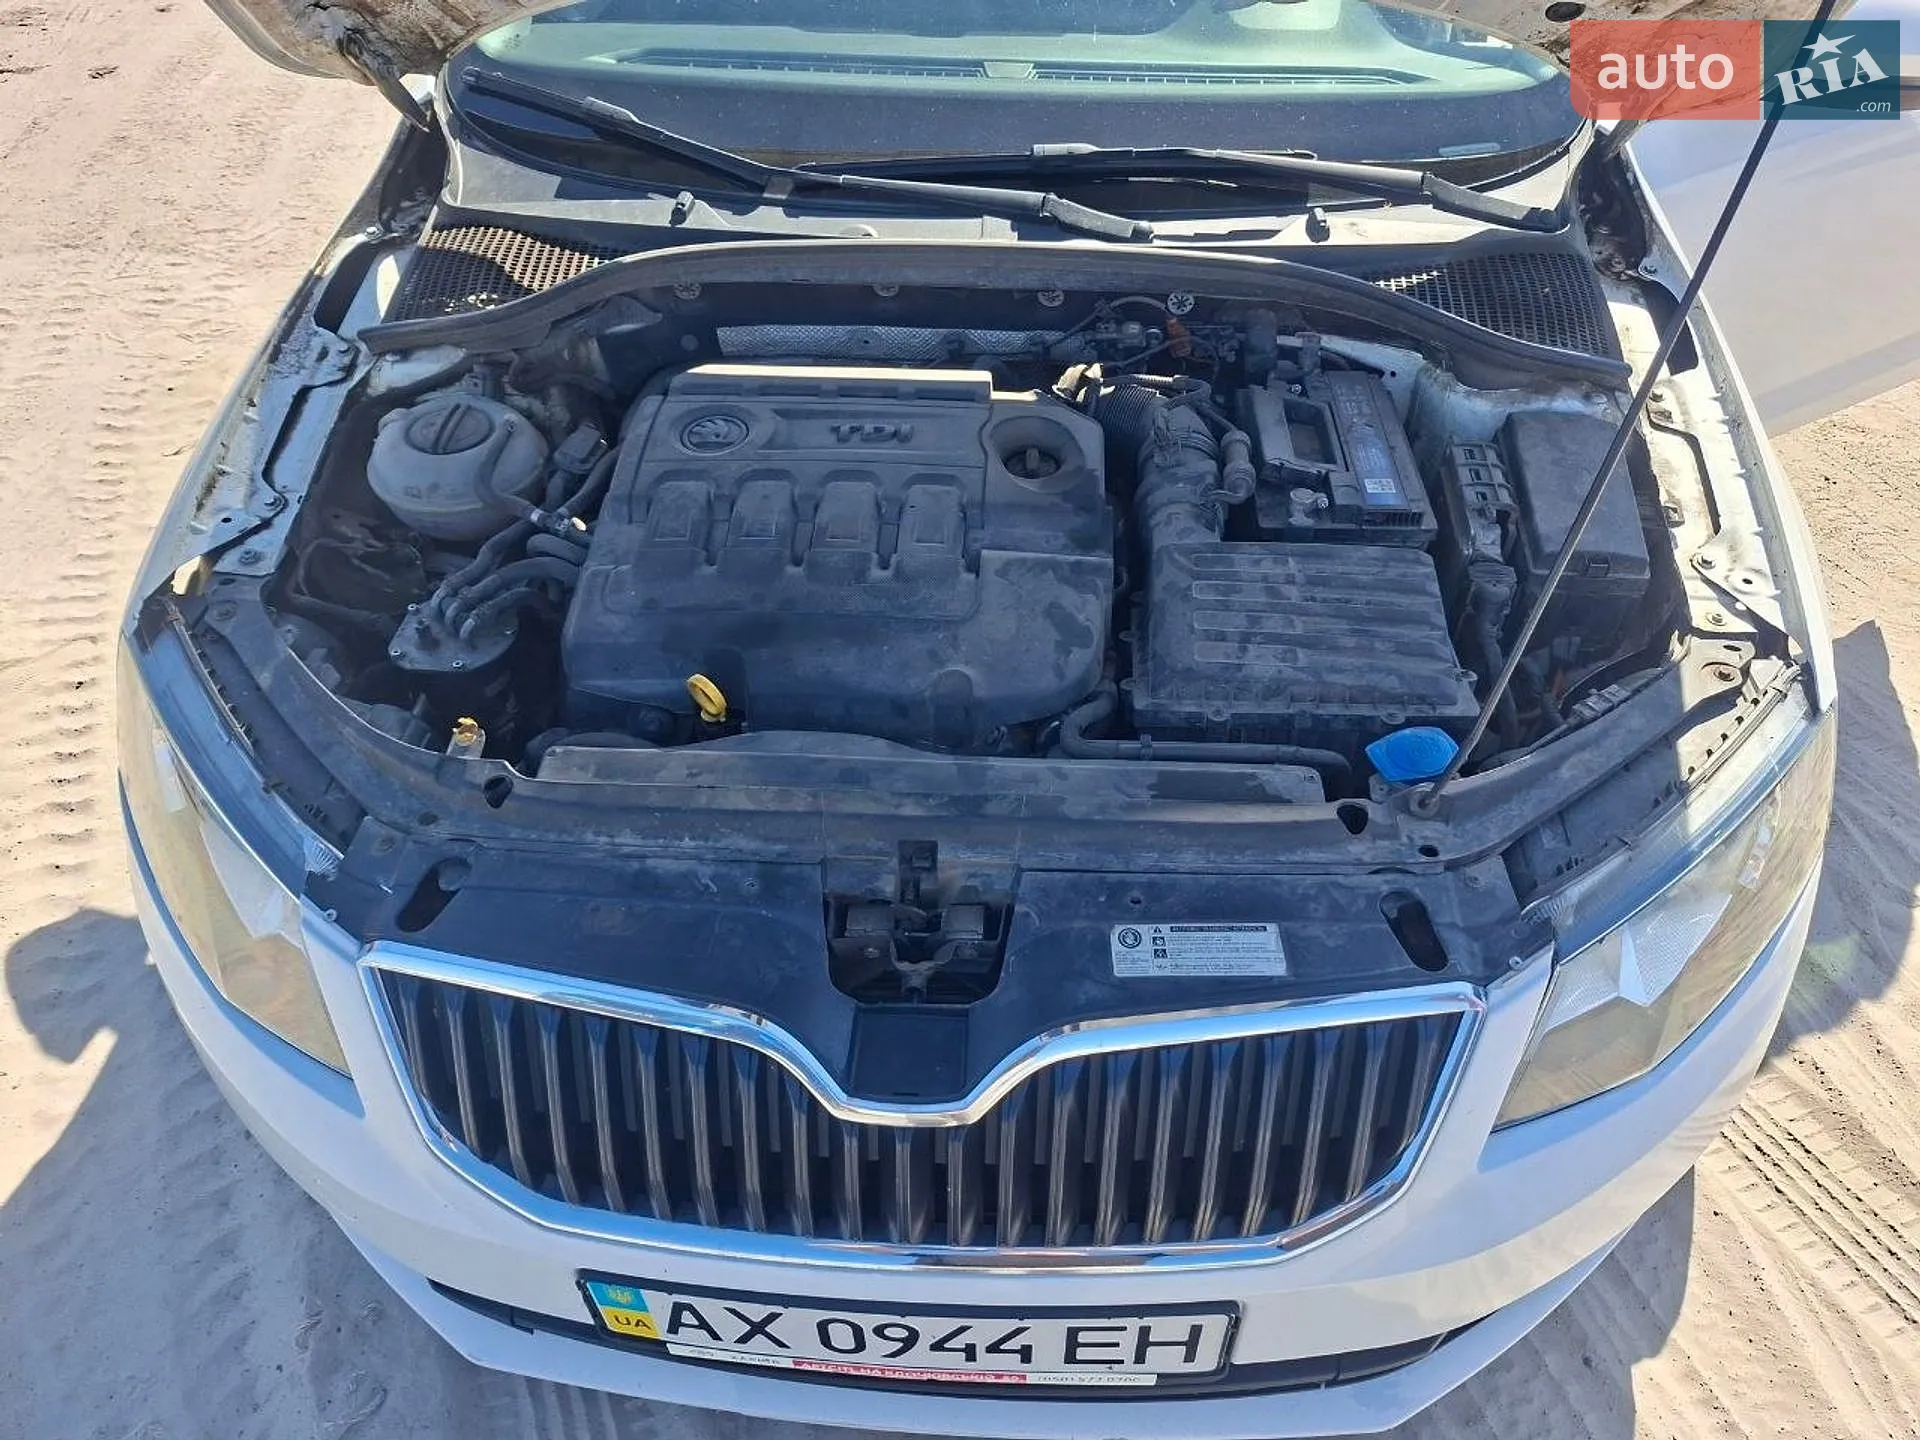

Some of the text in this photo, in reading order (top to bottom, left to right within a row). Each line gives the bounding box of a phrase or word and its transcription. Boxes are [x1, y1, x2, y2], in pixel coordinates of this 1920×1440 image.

[613, 1314, 653, 1331] UA
[666, 1301, 1203, 1365] AX 0944 EH
